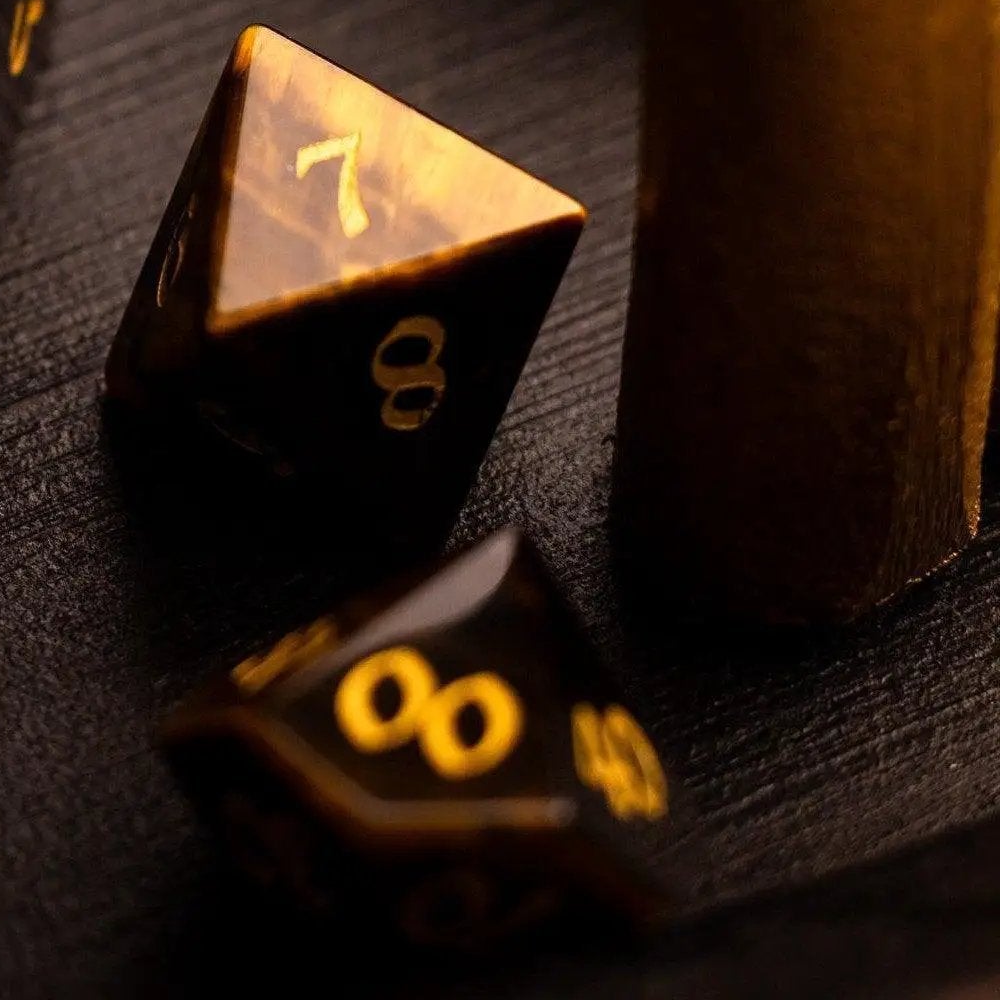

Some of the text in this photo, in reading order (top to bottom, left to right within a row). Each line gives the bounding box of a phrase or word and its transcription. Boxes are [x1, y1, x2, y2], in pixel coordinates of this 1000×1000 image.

[295, 132, 371, 239] 7
[370, 312, 449, 433] 8
[333, 643, 525, 783] 00
